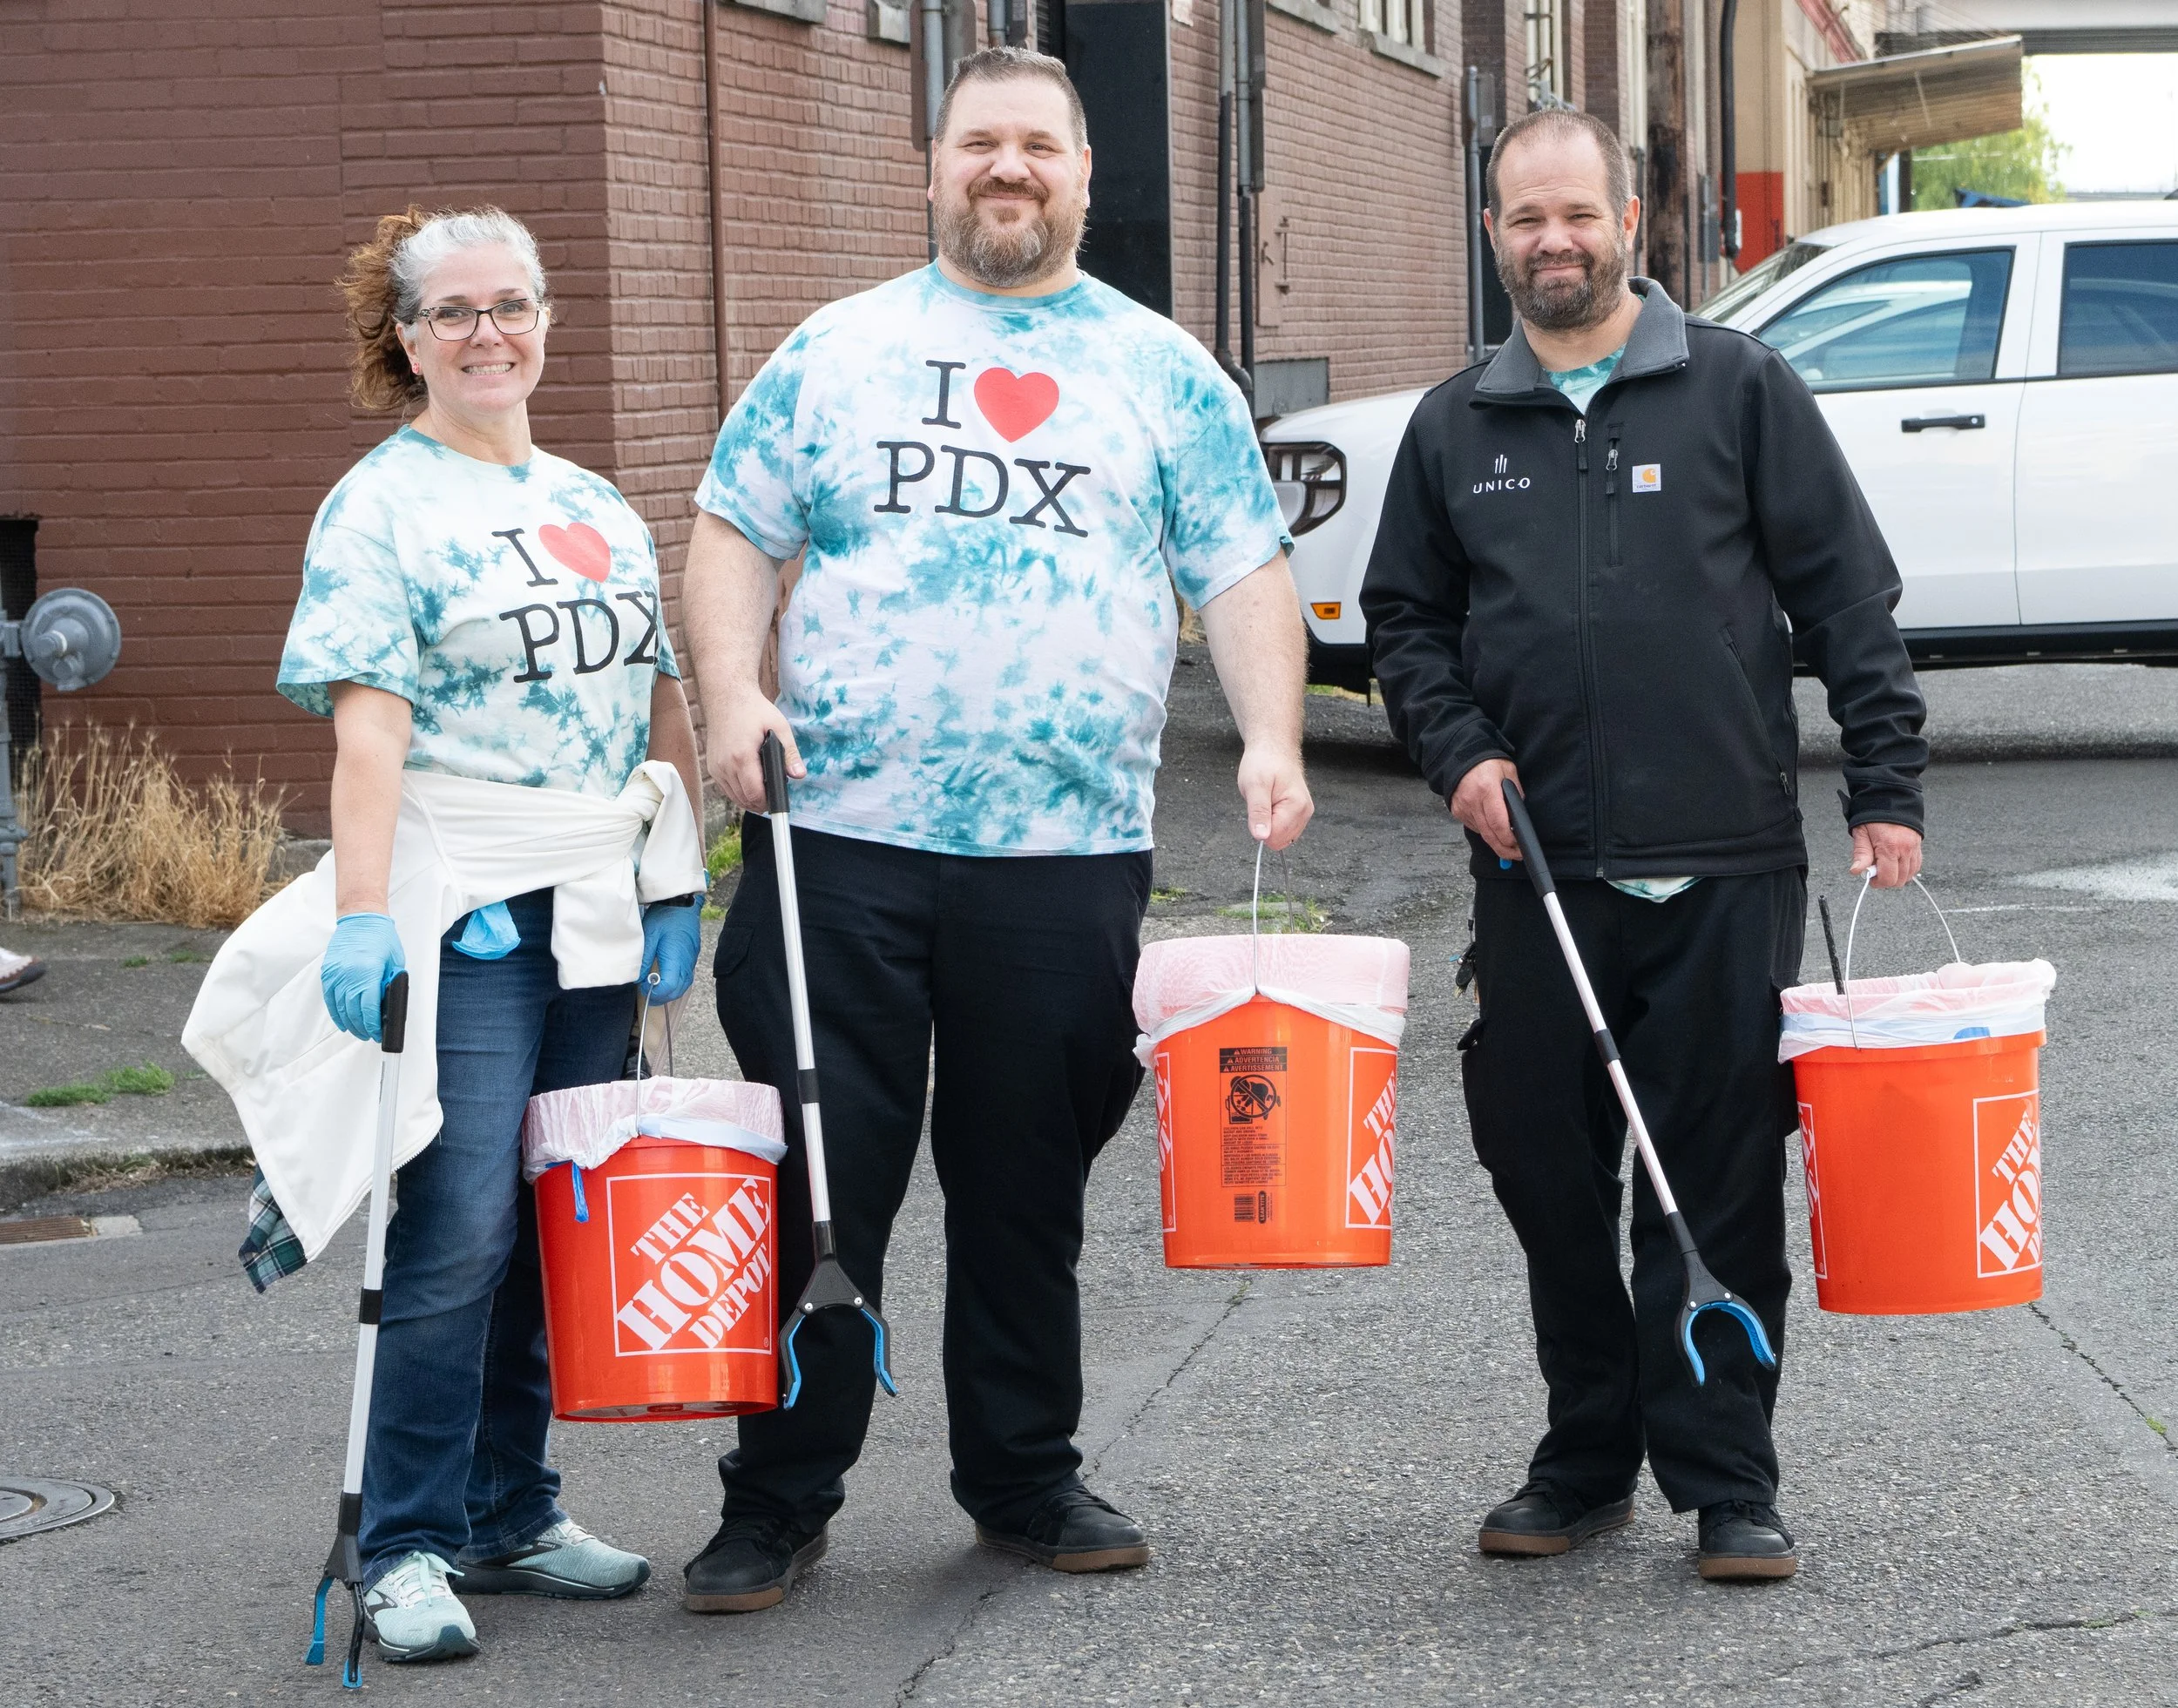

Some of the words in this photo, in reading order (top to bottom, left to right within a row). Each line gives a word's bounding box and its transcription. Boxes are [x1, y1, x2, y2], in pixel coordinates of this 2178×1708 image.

[921, 360, 966, 429] I
[874, 440, 1092, 538] PDX
[1473, 477, 1531, 494] UNICO
[491, 528, 558, 587] I
[498, 591, 659, 684] PDX
[1992, 1110, 2036, 1185] THE
[617, 1177, 771, 1351] HOME
[630, 1192, 710, 1265] THE
[688, 1242, 771, 1349] DEPOT
